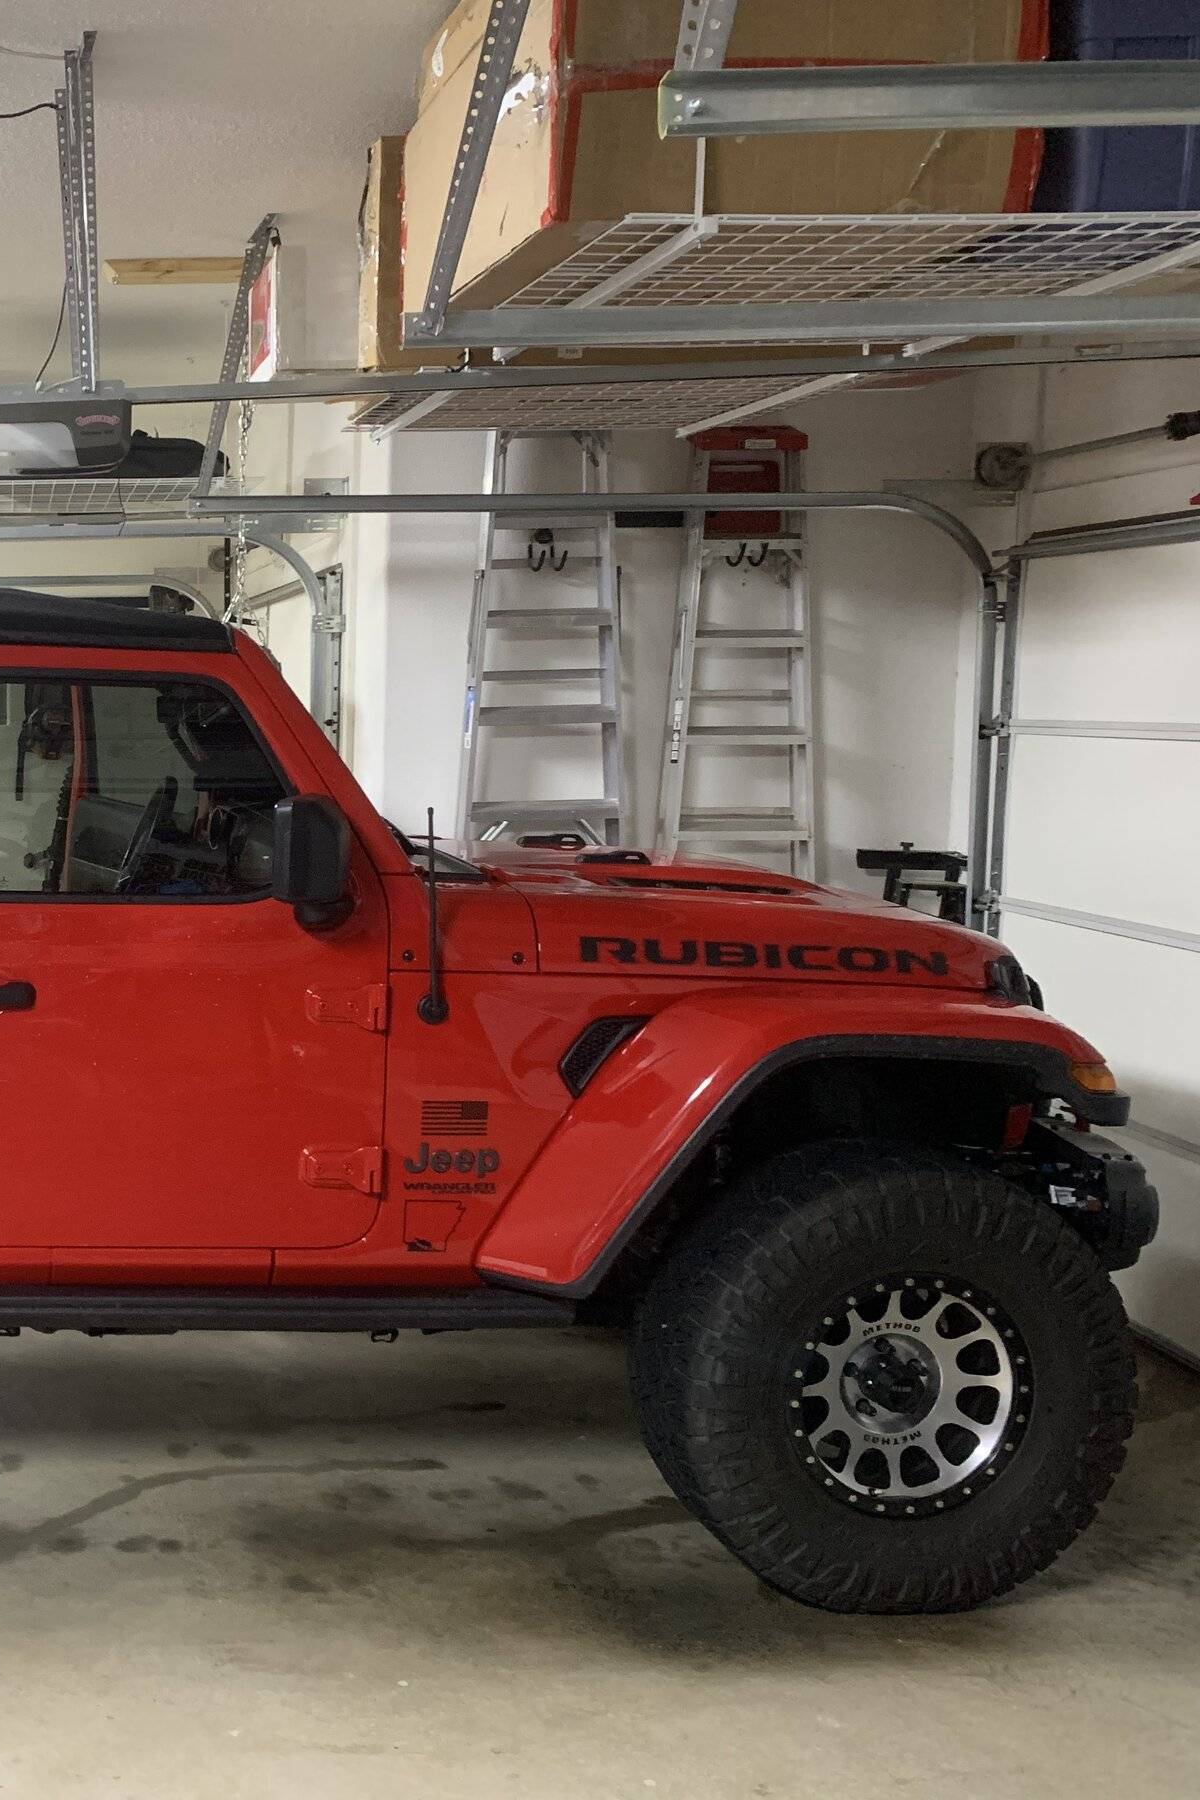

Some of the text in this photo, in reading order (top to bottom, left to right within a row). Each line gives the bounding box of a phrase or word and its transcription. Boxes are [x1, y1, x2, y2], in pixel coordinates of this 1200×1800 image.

[579, 934, 949, 976] RUBICON
[403, 1141, 500, 1179] Jeep
[403, 1182, 495, 1191] WRANGLER
[862, 1322, 921, 1337] METHOD
